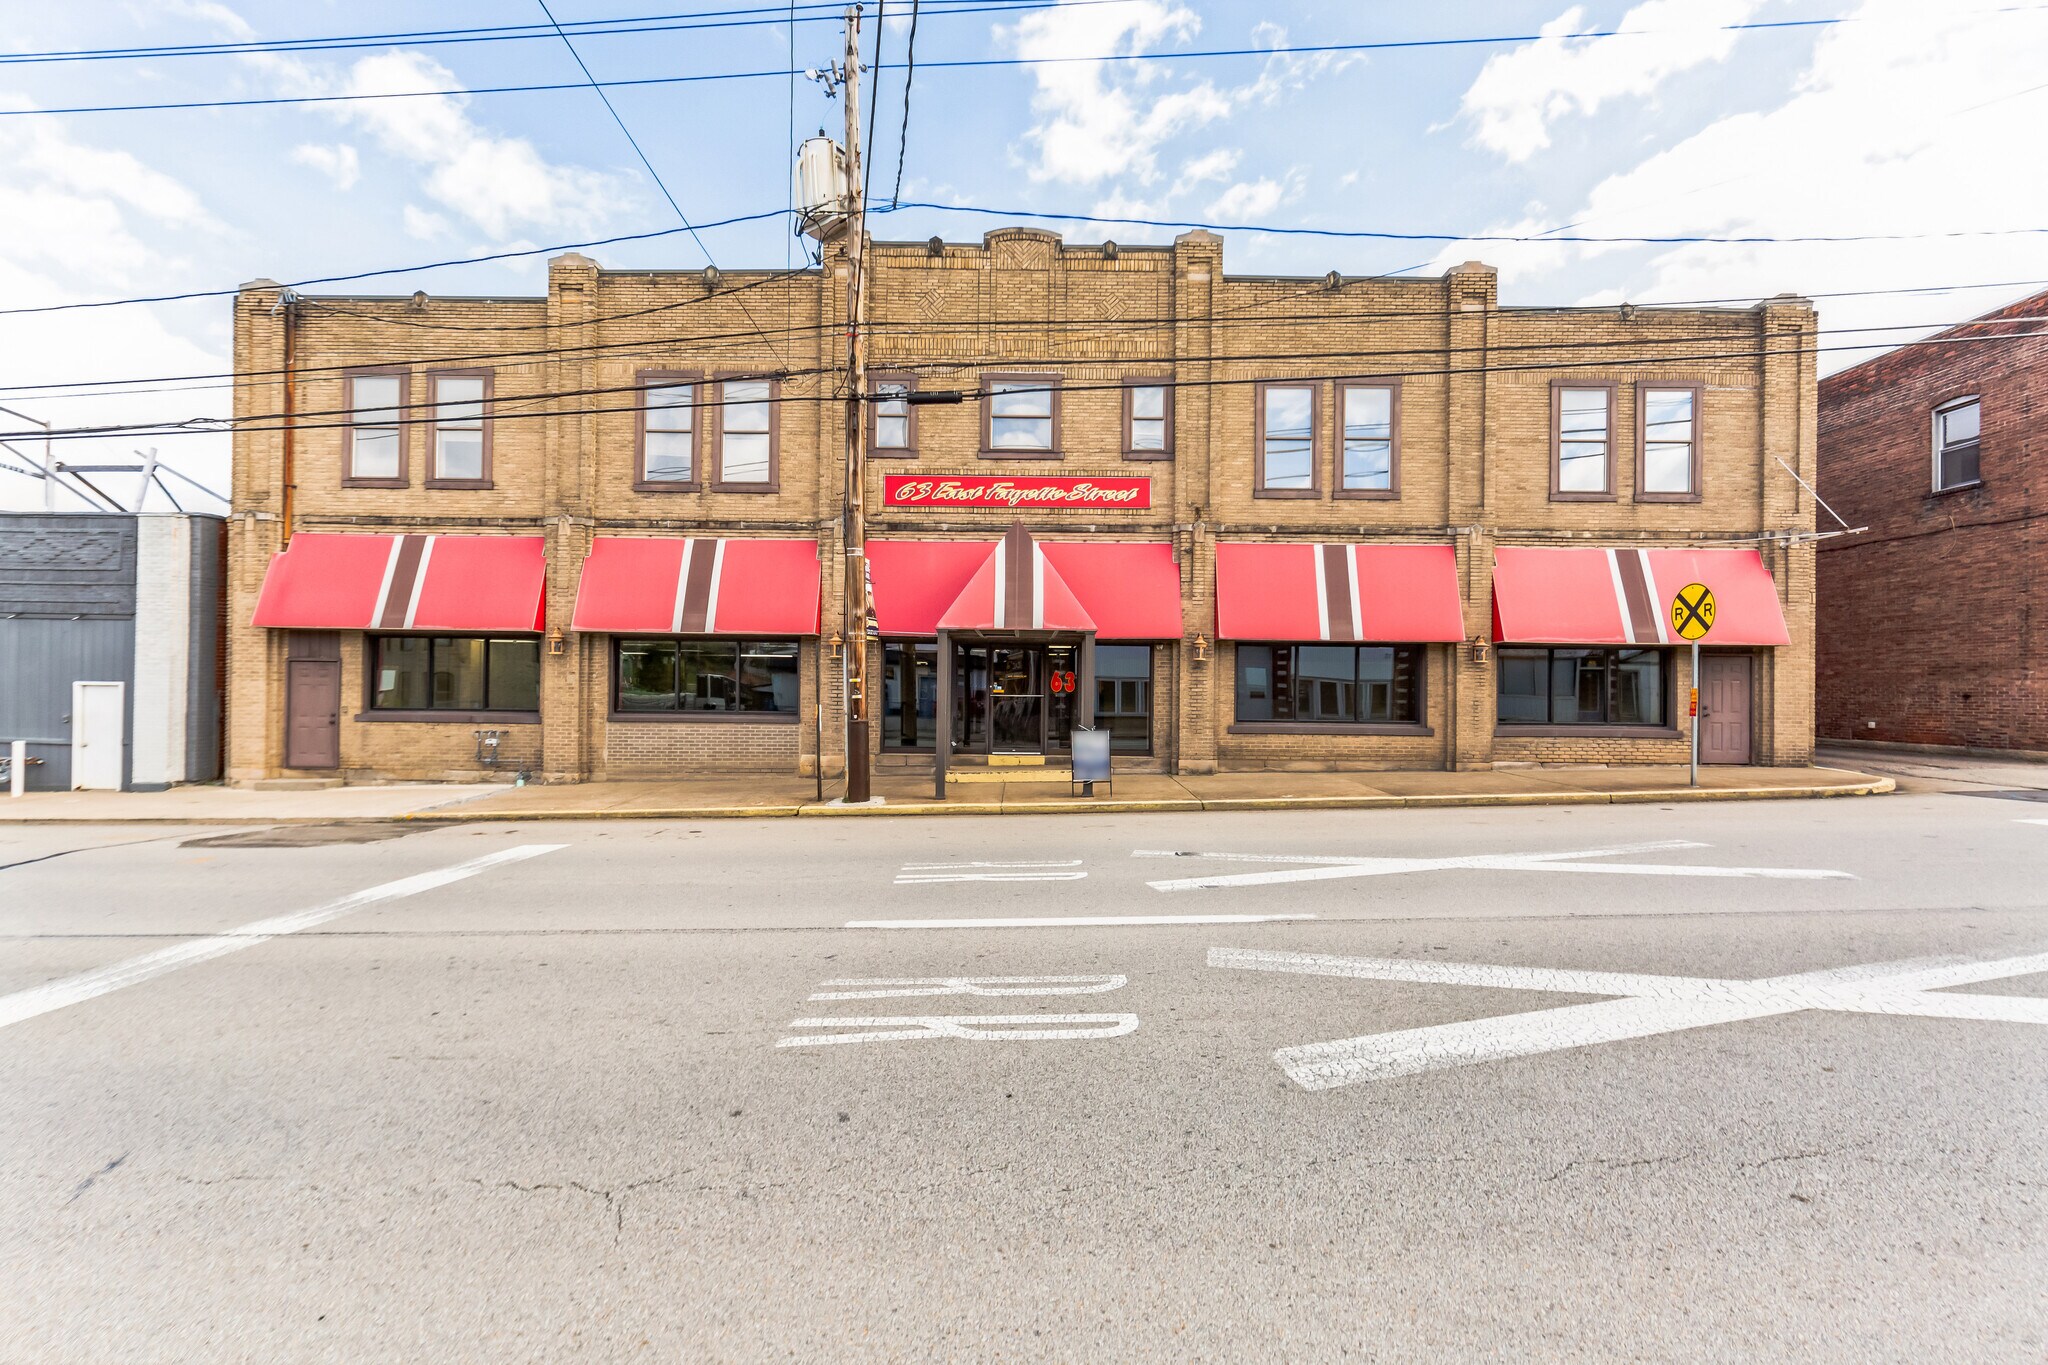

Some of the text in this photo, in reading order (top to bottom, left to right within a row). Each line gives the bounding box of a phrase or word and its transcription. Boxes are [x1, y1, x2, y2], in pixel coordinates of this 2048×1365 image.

[896, 482, 1137, 505] 63 East Fayette Street
[1675, 602, 1713, 621] R R
[1051, 670, 1076, 693] 63
